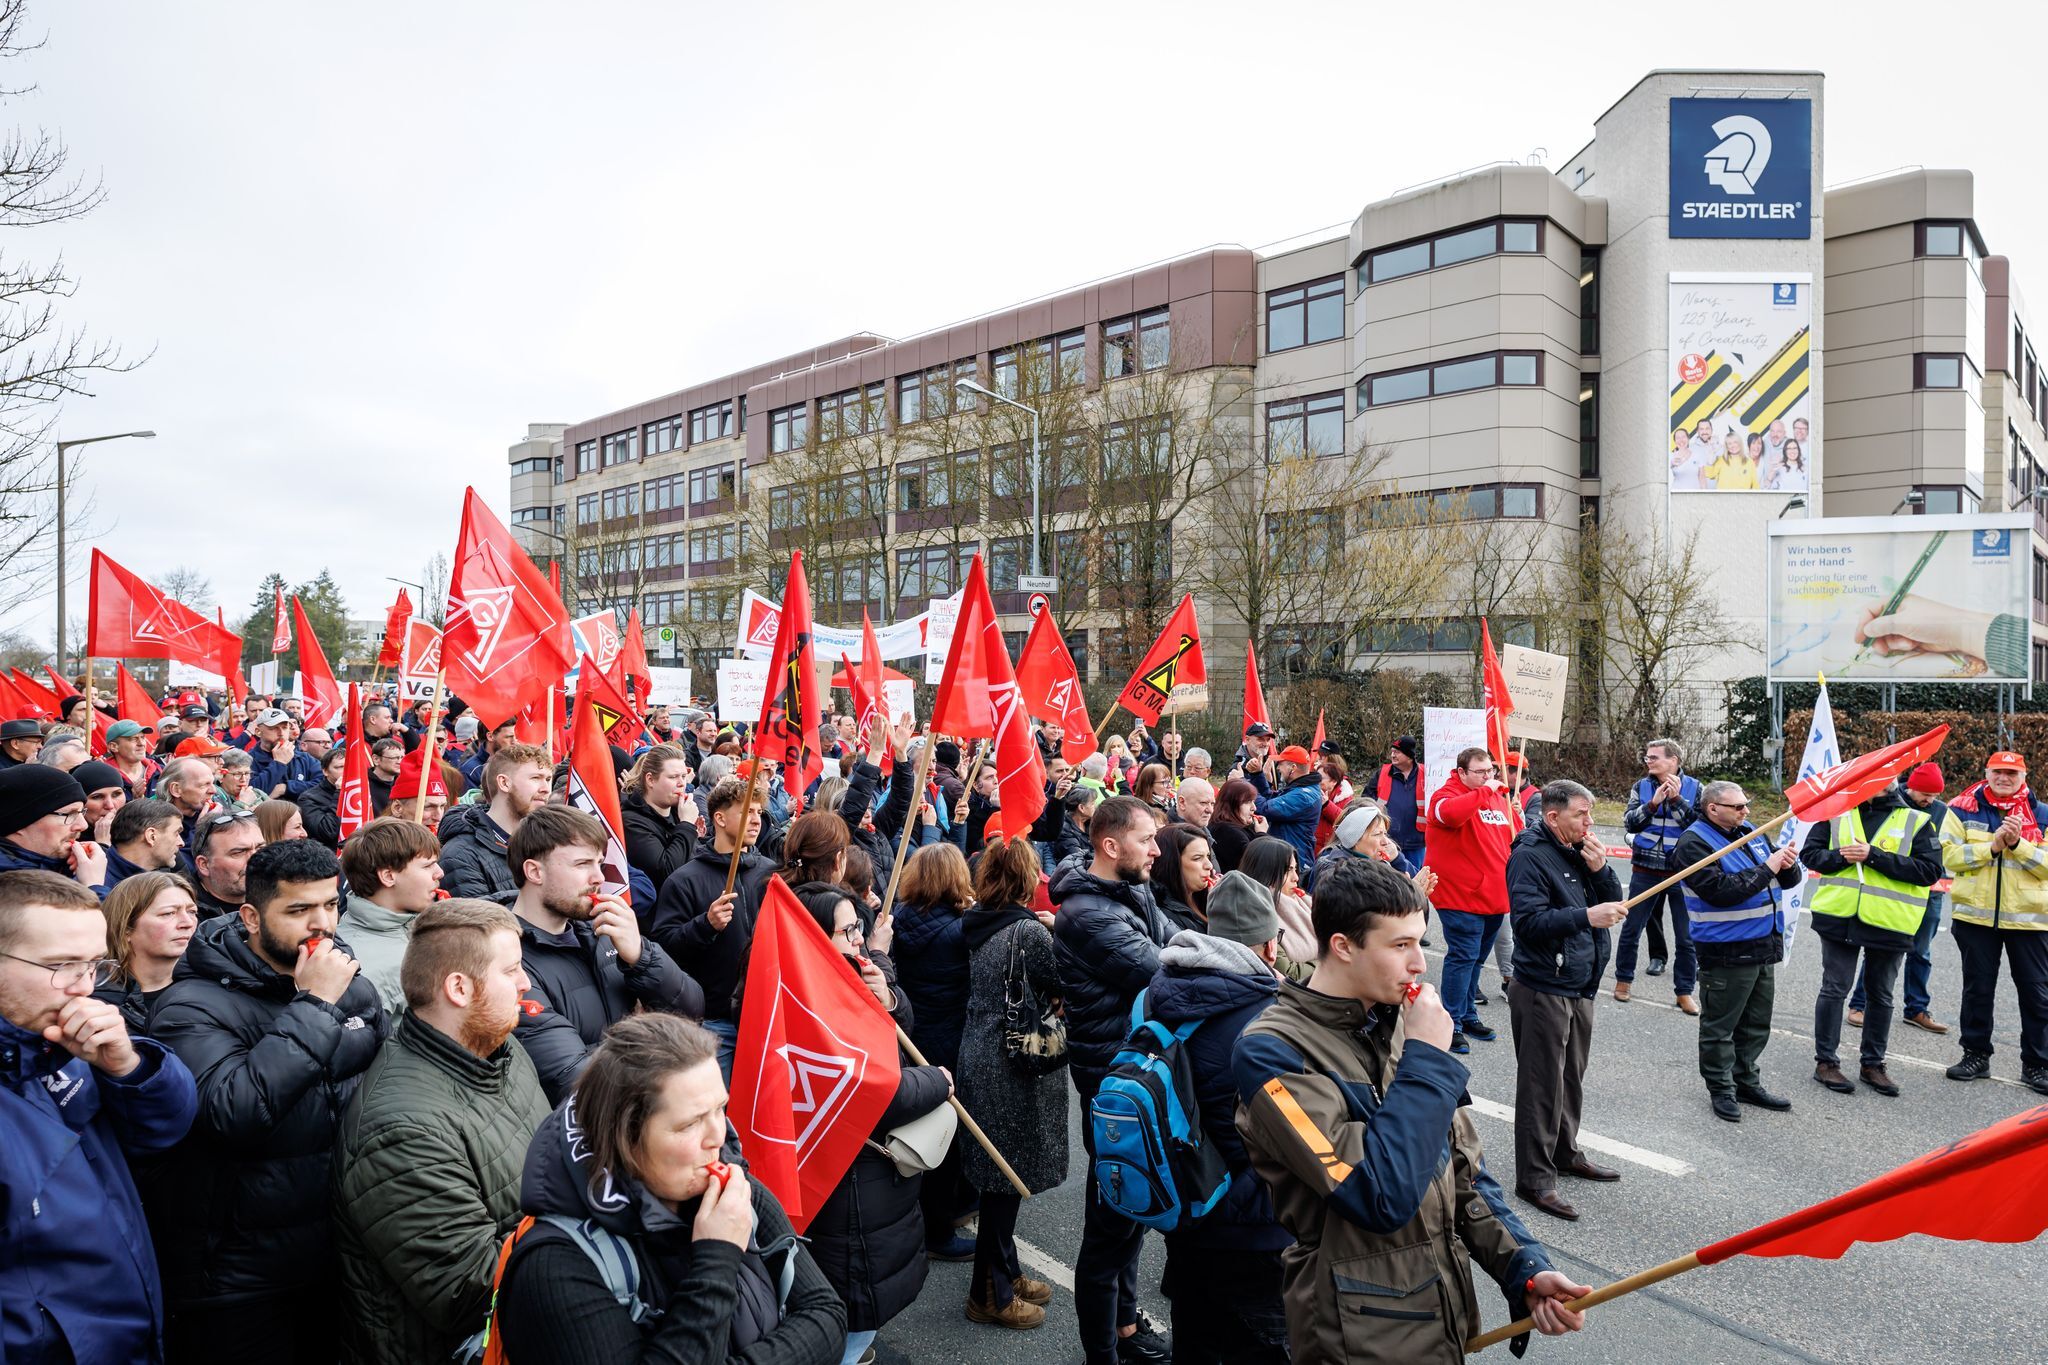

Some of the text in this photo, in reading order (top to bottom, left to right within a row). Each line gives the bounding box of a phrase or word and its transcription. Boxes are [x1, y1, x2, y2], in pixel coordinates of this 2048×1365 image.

[1682, 202, 1797, 219] STAEDTLER
[1680, 311, 1757, 329] 125 Years
[1697, 331, 1769, 350] Creativity
[1787, 545, 1852, 555] Wir haben es
[1787, 558, 1797, 567] in
[1800, 558, 1816, 567] der
[1819, 557, 1845, 567] Hand
[1026, 580, 1051, 588] Neunhof
[1787, 572, 1868, 584] Upcycling für eine
[1787, 584, 1880, 596] nachhaltige Zukunft.
[813, 633, 858, 647] ymobil
